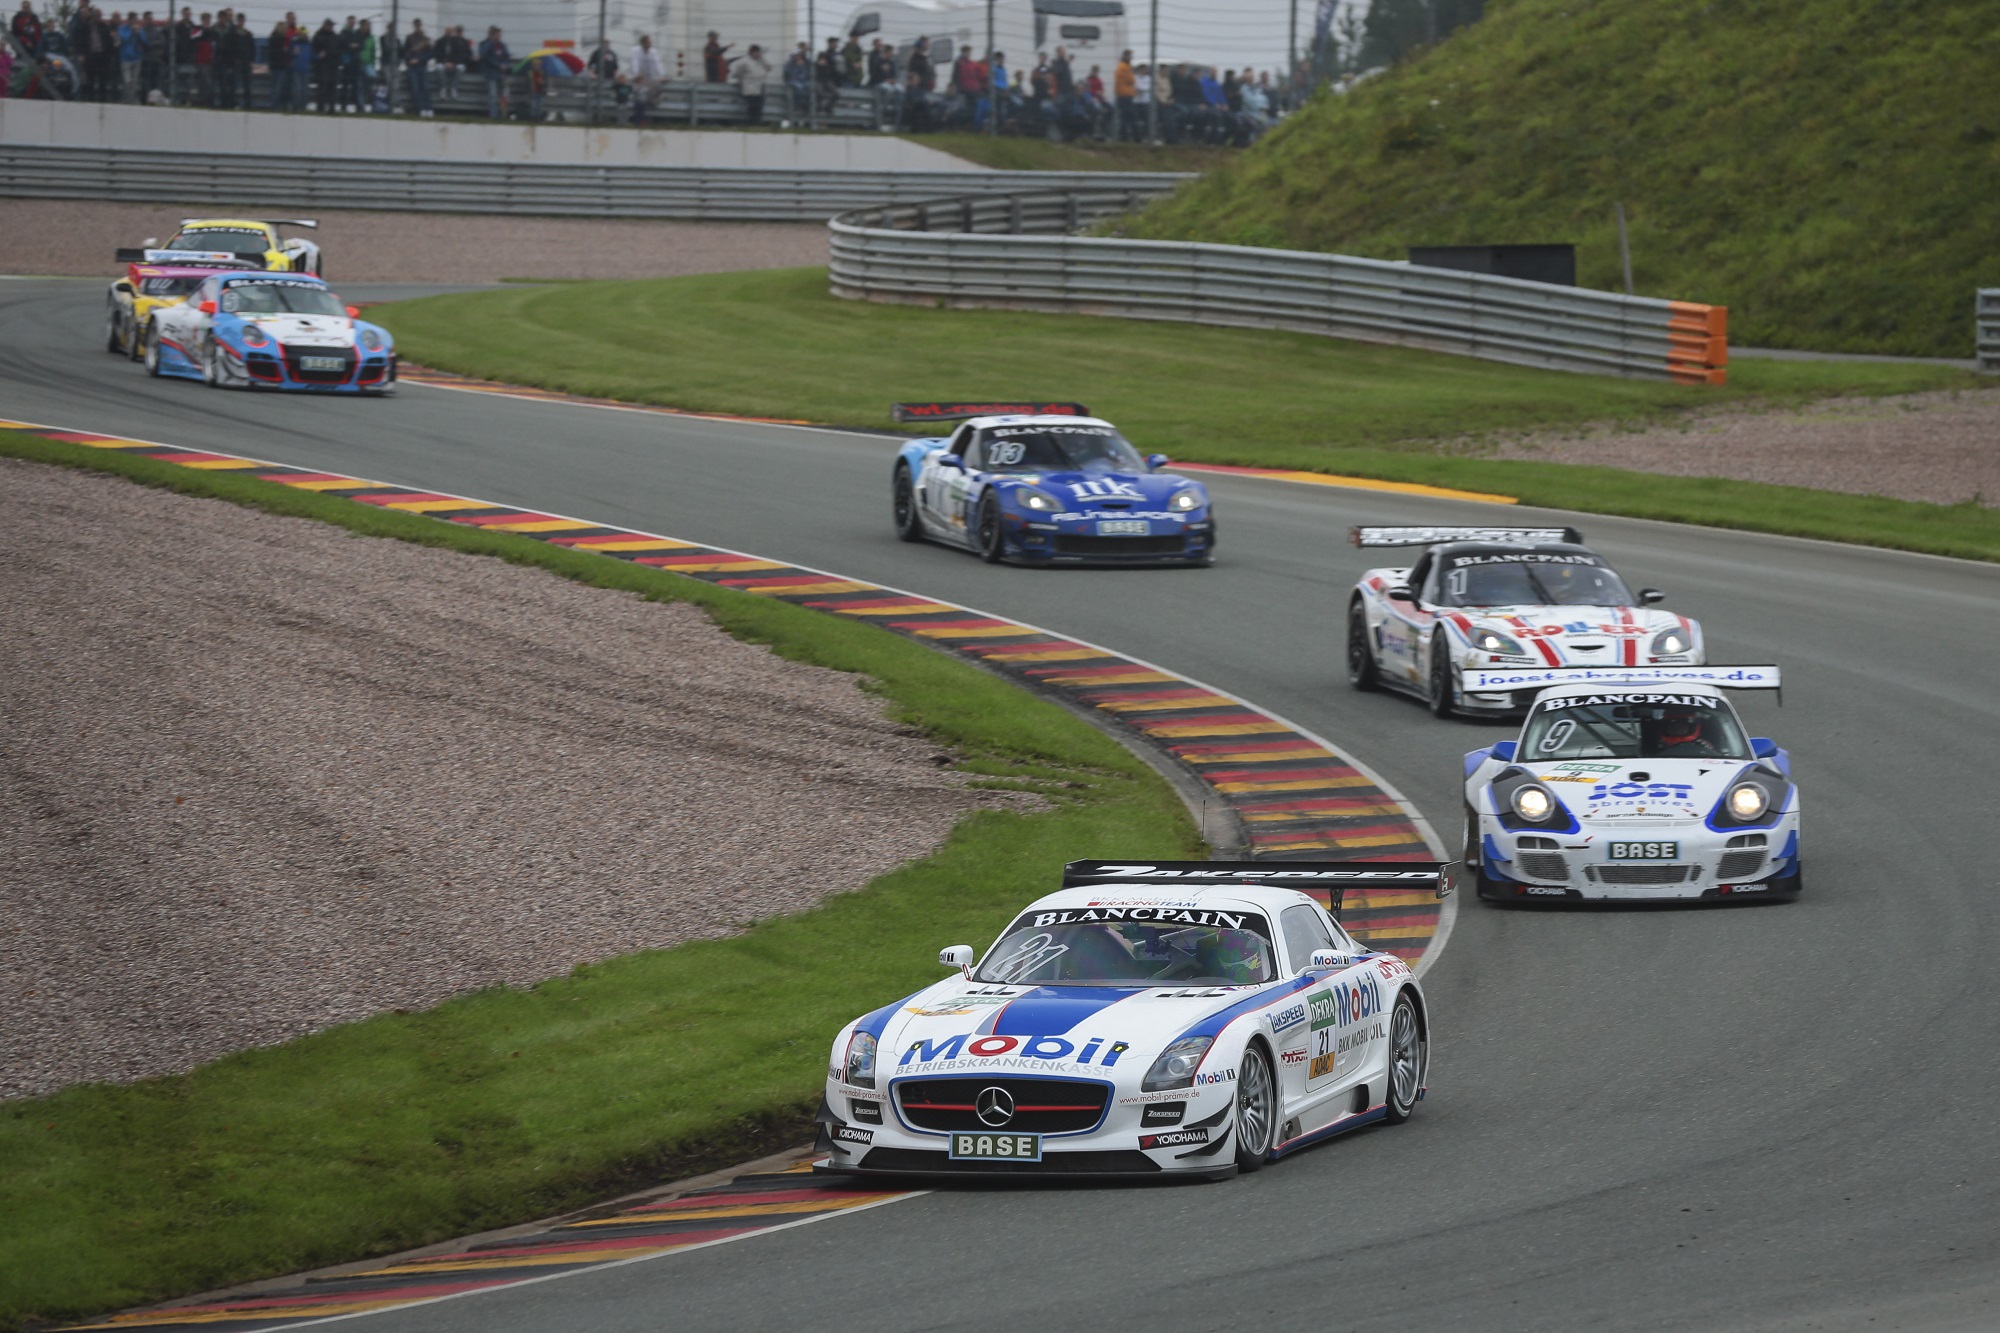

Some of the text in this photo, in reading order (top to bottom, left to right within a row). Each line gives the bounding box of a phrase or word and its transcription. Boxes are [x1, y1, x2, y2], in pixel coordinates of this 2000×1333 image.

[988, 441, 1026, 465] 13
[1453, 553, 1595, 567] BLANCPAIN
[1449, 568, 1469, 596] 1
[1478, 670, 1764, 687] joest-abrasives.de
[1543, 693, 1718, 712] BLANCPAIN
[1538, 719, 1577, 753] 9
[1559, 763, 1615, 773] DEKRA
[1588, 782, 1694, 801] JÖST
[1588, 799, 1695, 809] abrasives
[1612, 842, 1676, 859] BASE
[1033, 907, 1247, 930] BLANCPAIN
[986, 932, 1070, 985] 21
[1314, 955, 1343, 966] Mobil
[1333, 970, 1382, 1029] Mobil
[1265, 1002, 1306, 1034] ZAKSPEED
[1310, 996, 1336, 1025] DEKRA
[1318, 1027, 1330, 1056] 21
[1338, 1022, 1387, 1055] BKK MOBIL OIL
[898, 1032, 1130, 1068] Mobil
[894, 1057, 1113, 1078] BETRIEBSKRANKENKASSE
[1313, 1055, 1331, 1077] ADAC
[1196, 1070, 1226, 1086] Mobil
[1119, 1089, 1201, 1104] www.mobil-prämie.de
[1148, 1109, 1181, 1118] ZAKSPEED
[838, 1128, 871, 1143] YOKOHAMA
[1156, 1131, 1208, 1145] YOKOHAMA
[958, 1136, 1033, 1156] BASE
